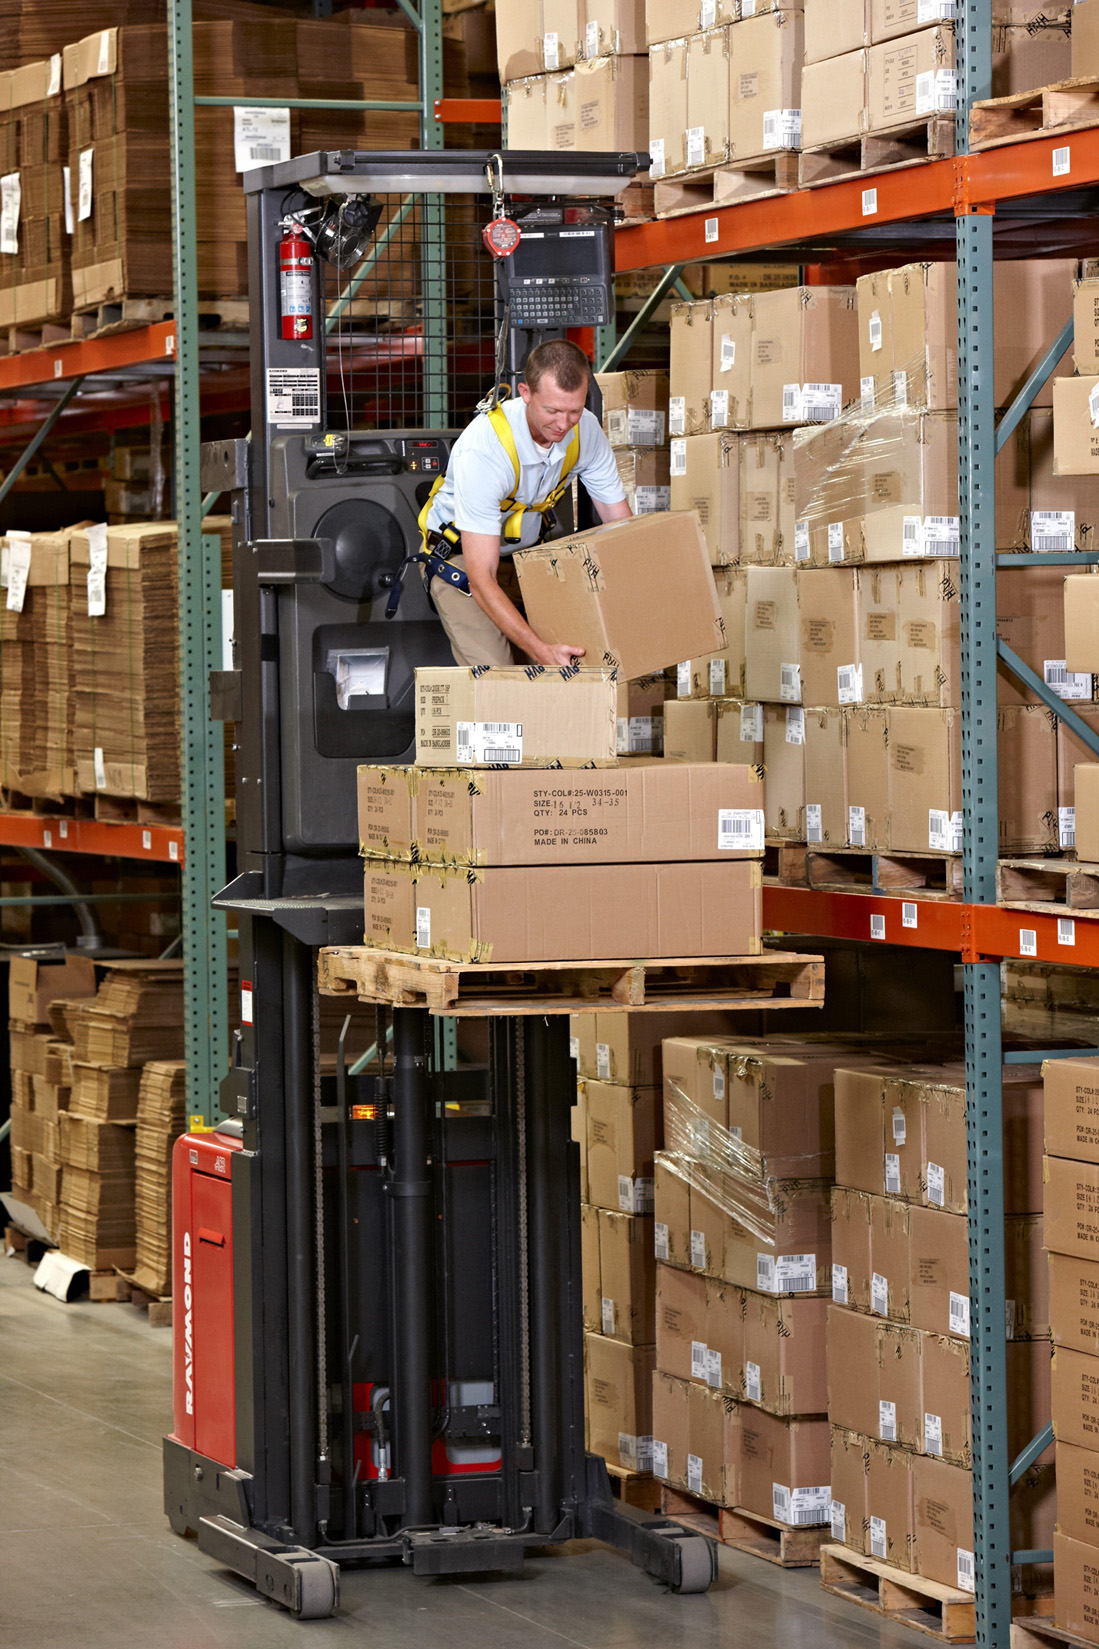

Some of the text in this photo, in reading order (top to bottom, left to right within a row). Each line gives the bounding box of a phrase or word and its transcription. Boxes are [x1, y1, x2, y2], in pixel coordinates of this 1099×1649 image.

[583, 558, 600, 578] PVH
[533, 790, 628, 798] STY-COL#:25-W0315-001
[592, 798, 620, 806] 34-35
[184, 1232, 193, 1416] RAYMOND
[1081, 1328, 1090, 1336] MADE
[1084, 1615, 1094, 1624] MADE
